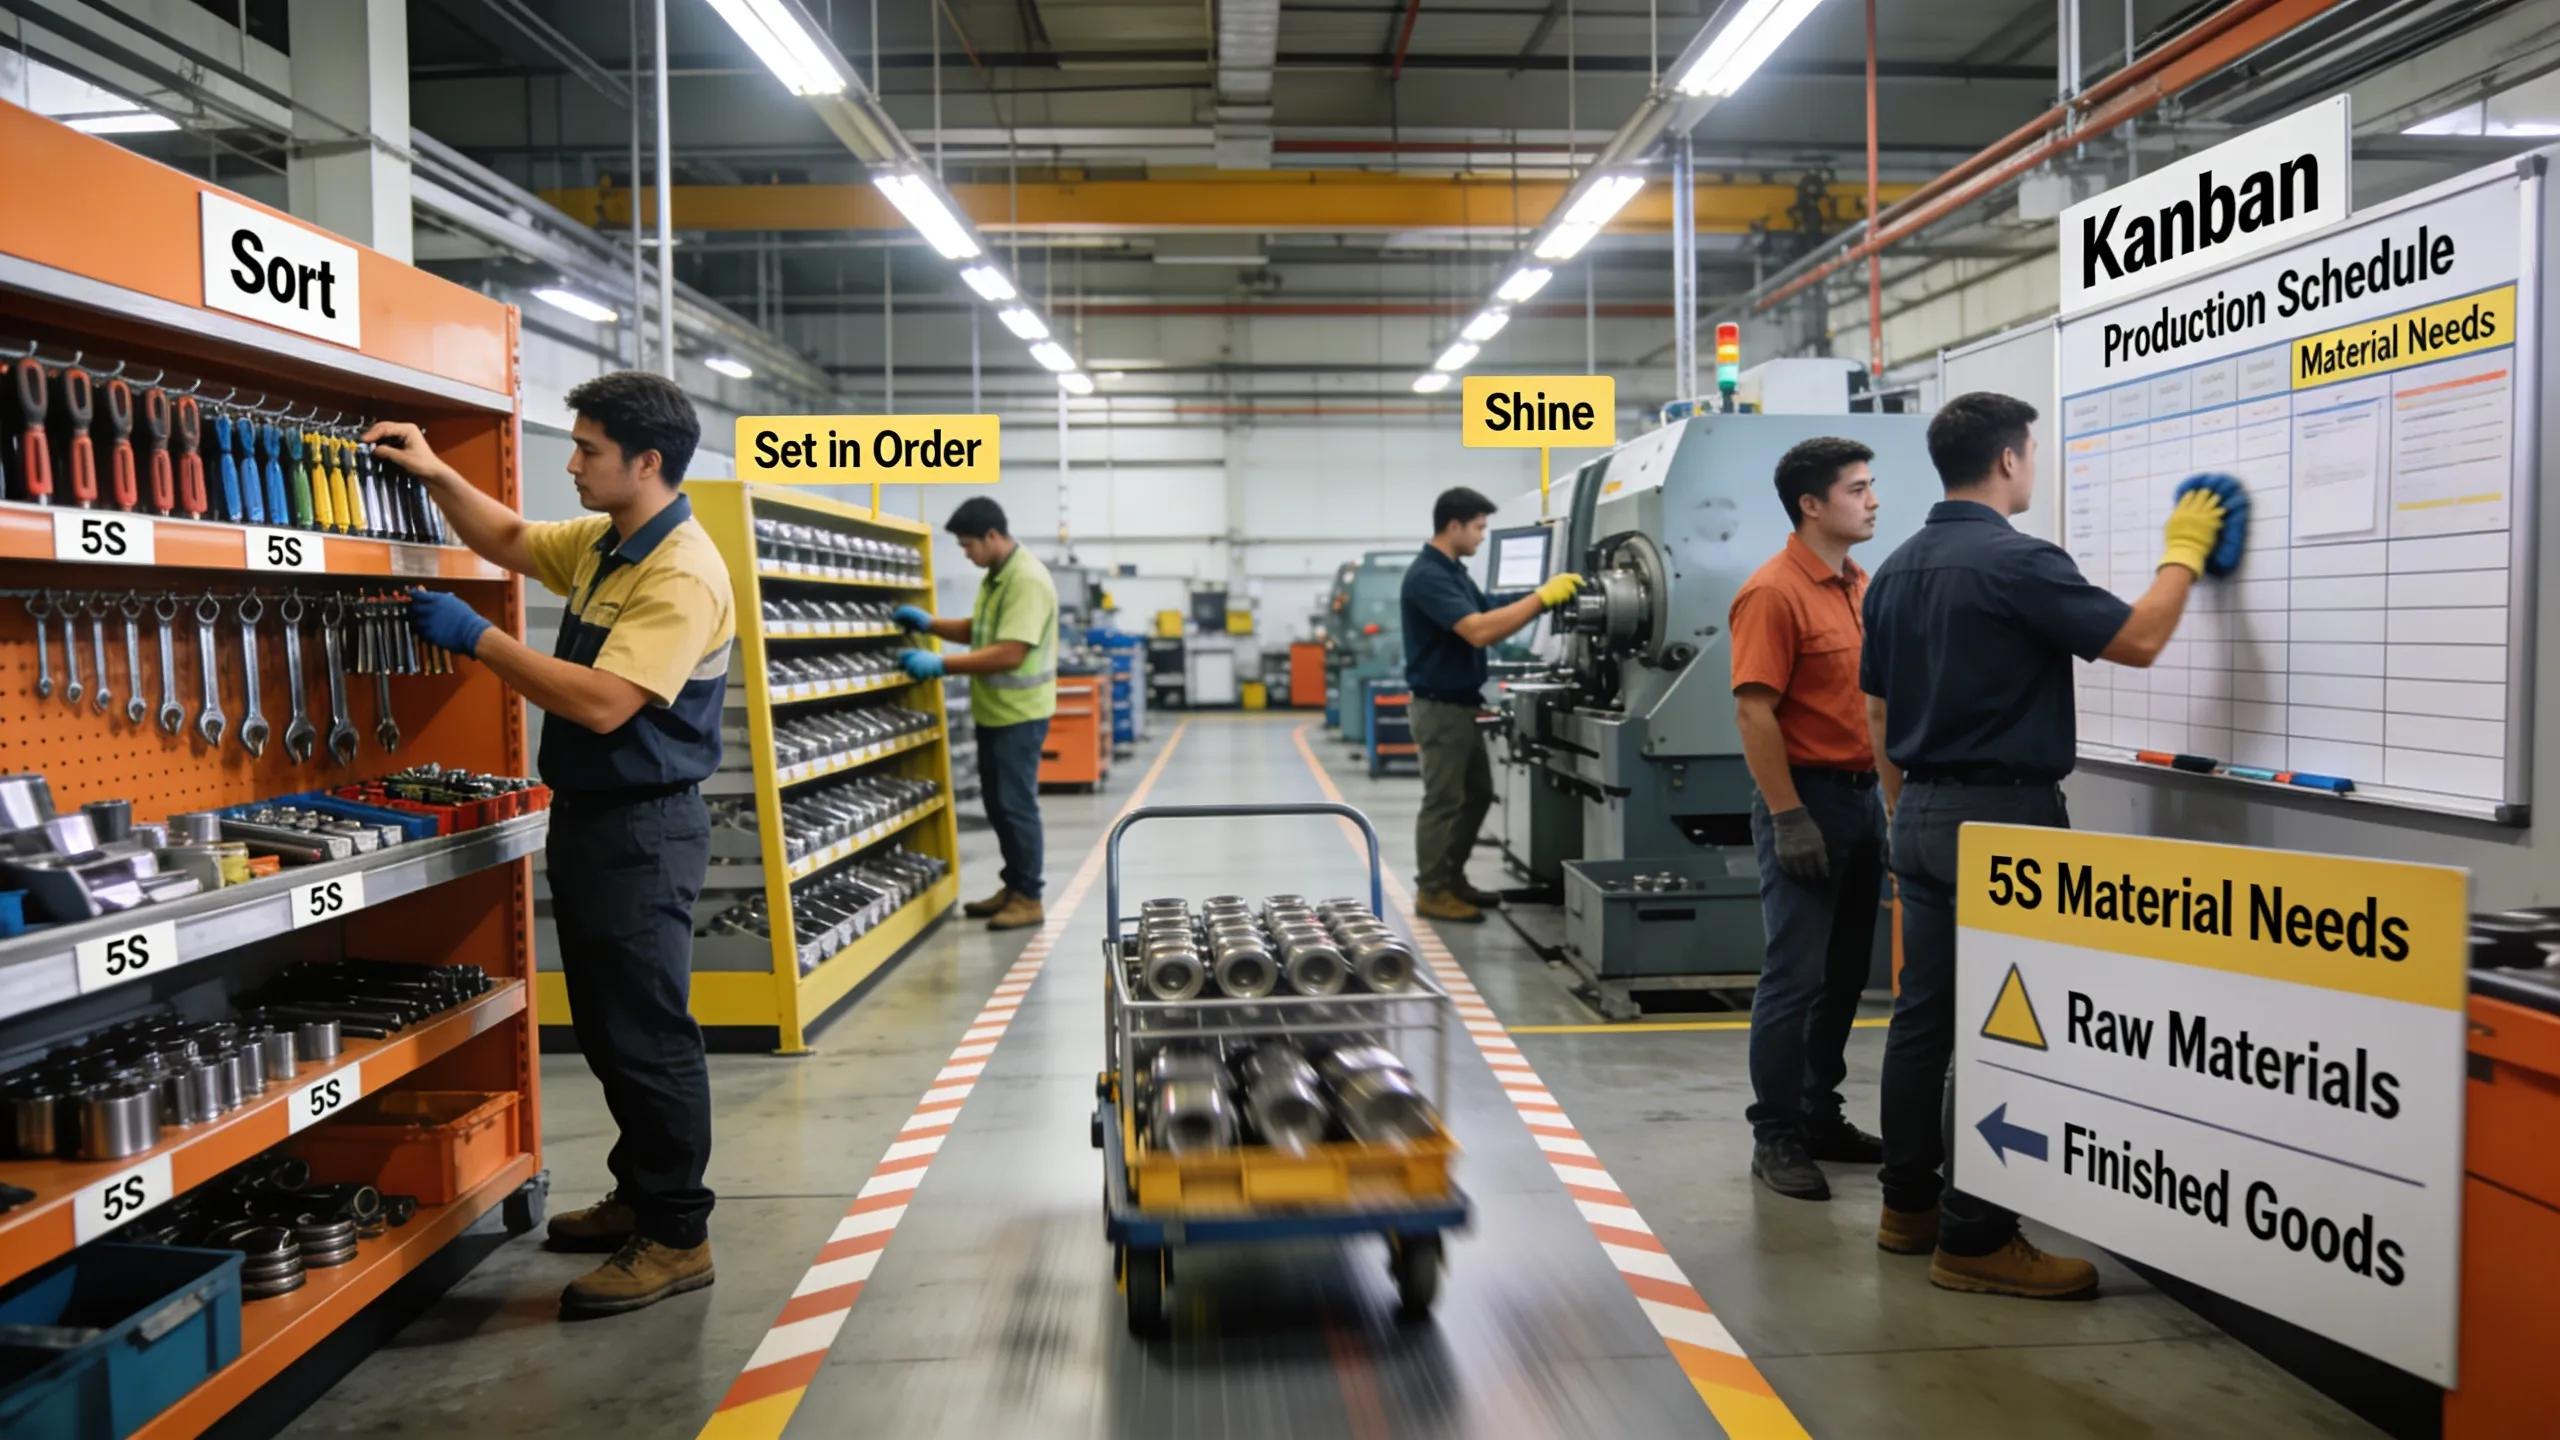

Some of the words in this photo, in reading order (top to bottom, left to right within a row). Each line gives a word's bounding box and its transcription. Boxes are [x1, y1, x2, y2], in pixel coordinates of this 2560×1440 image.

[2083, 153, 2319, 289] Kanban
[230, 228, 336, 319] Sort
[2104, 290, 2266, 368] Production
[2277, 225, 2455, 318] Schedule
[2301, 323, 2398, 379] Material
[2408, 303, 2496, 355] Needs
[1485, 391, 1595, 432] Shine
[754, 430, 818, 469] Set
[828, 429, 861, 468] in
[873, 428, 982, 468] Order
[81, 519, 127, 556] 5S
[268, 535, 302, 567] 5S
[310, 881, 343, 916] 5S
[1988, 855, 2042, 910] 5S
[2057, 862, 2233, 937] Material
[2250, 883, 2409, 962] Needs
[106, 934, 150, 976] 5S
[2068, 990, 2154, 1060] Raw
[2168, 1010, 2400, 1120] Materials
[310, 1078, 341, 1116] 5S
[104, 1175, 145, 1221] 5S
[2064, 1122, 2229, 1228] Finished
[2245, 1180, 2405, 1287] Goods
